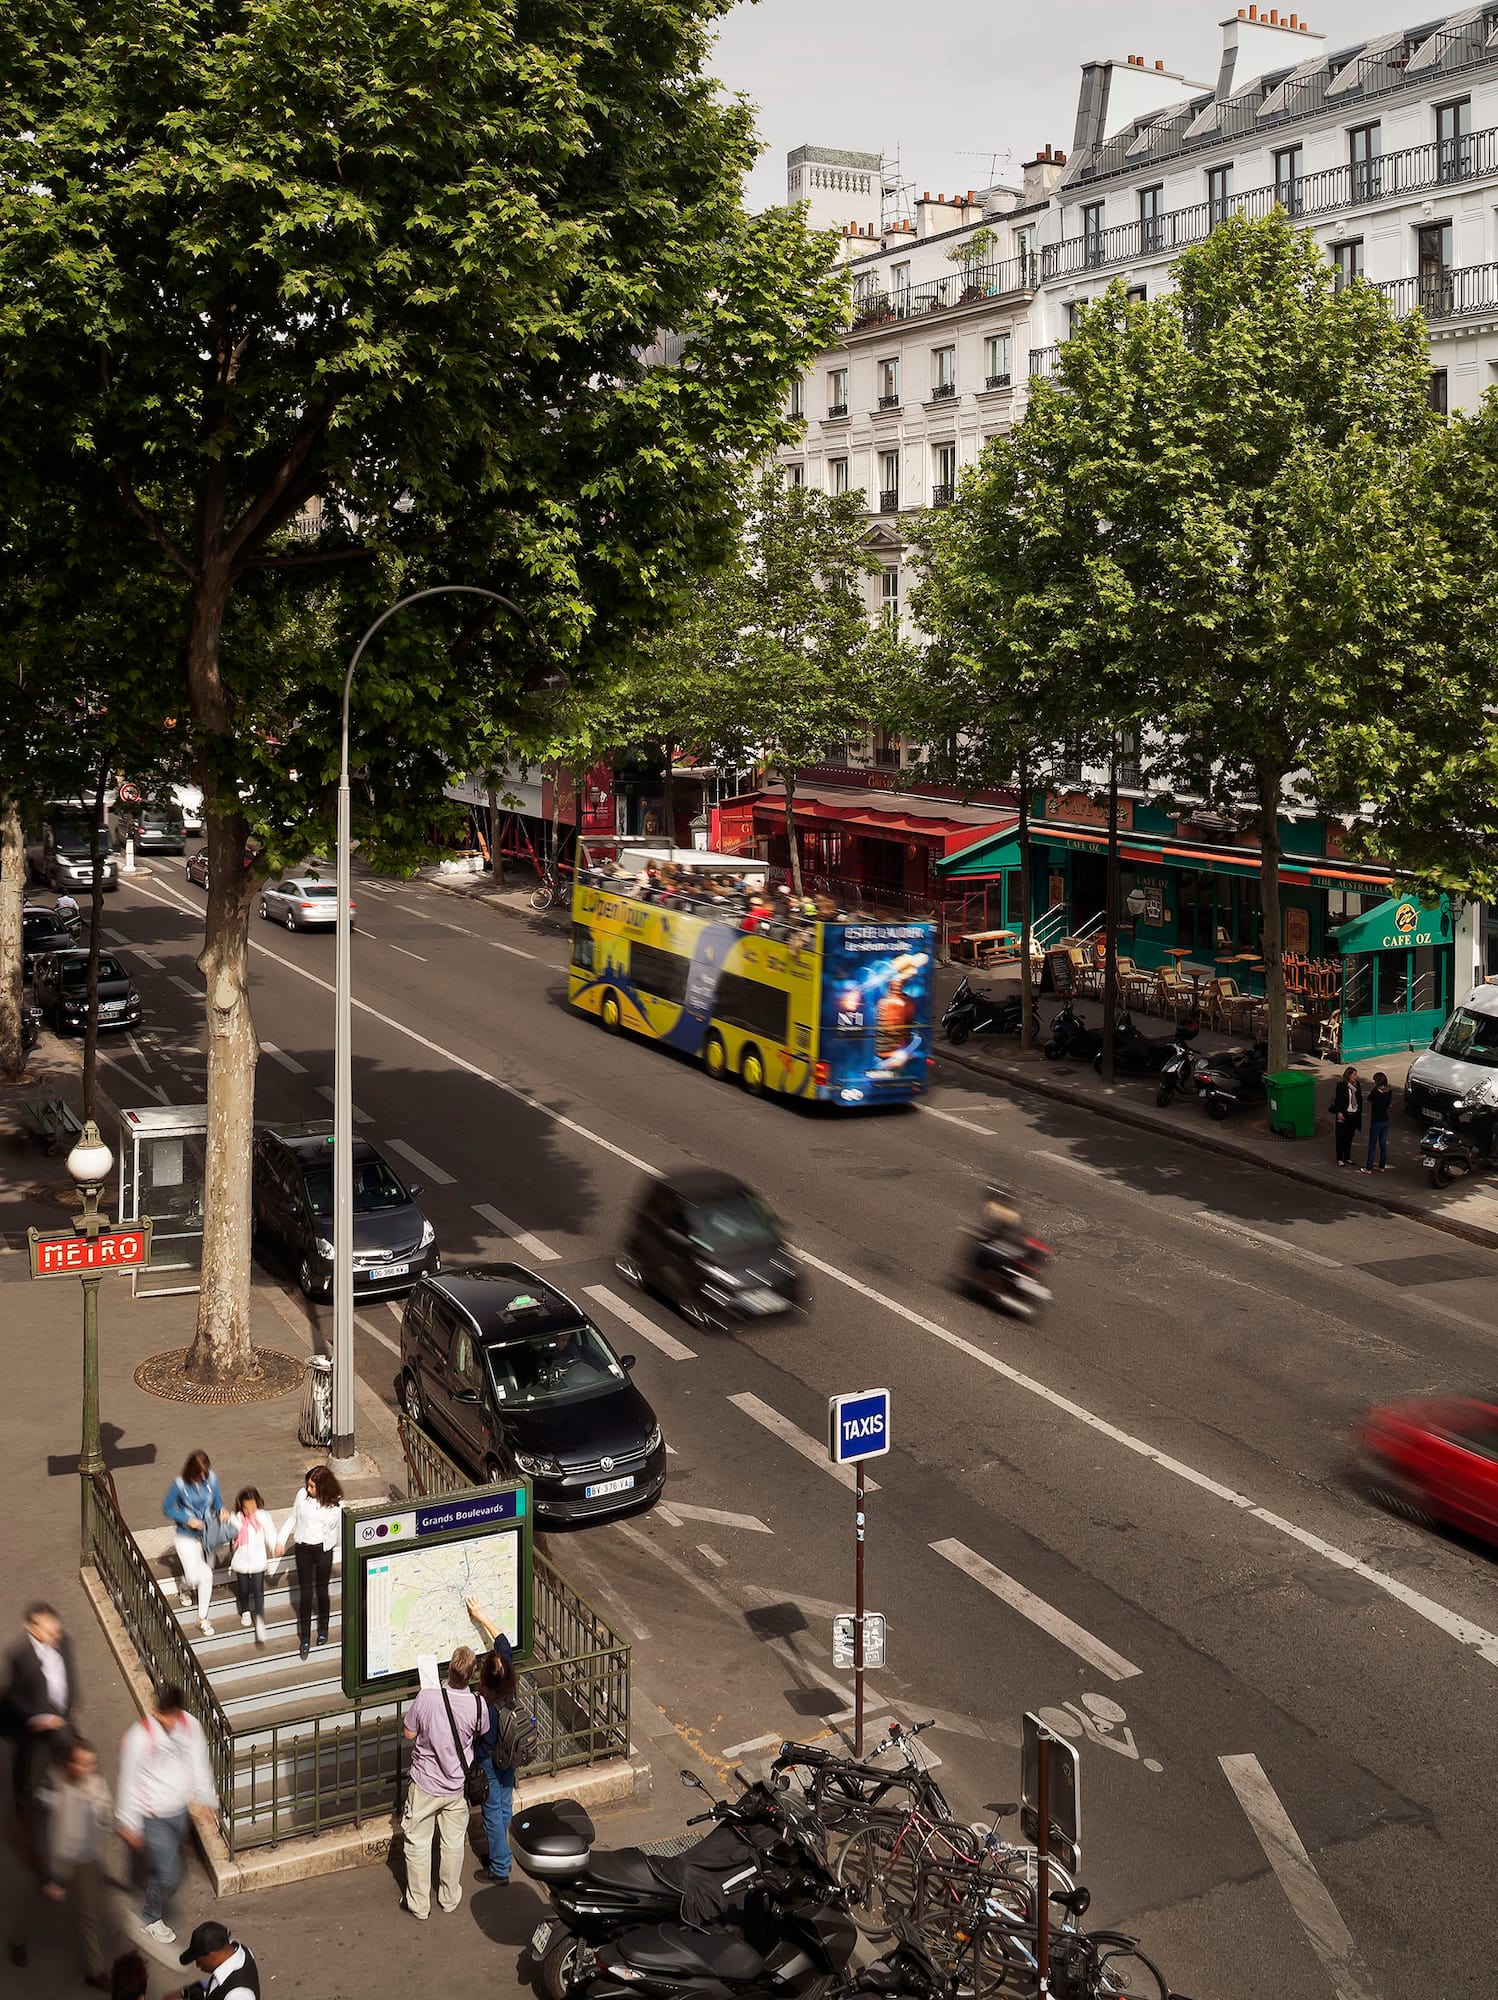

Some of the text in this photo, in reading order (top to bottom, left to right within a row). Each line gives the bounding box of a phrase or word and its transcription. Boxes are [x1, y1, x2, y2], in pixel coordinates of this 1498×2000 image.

[1066, 840, 1087, 850] CAFE
[1316, 877, 1333, 886] THE
[1382, 933, 1432, 947] CAFE OZ
[44, 1237, 138, 1268] METRO
[842, 1414, 884, 1441] TAXIS
[422, 1504, 504, 1527] Grands Boulevards
